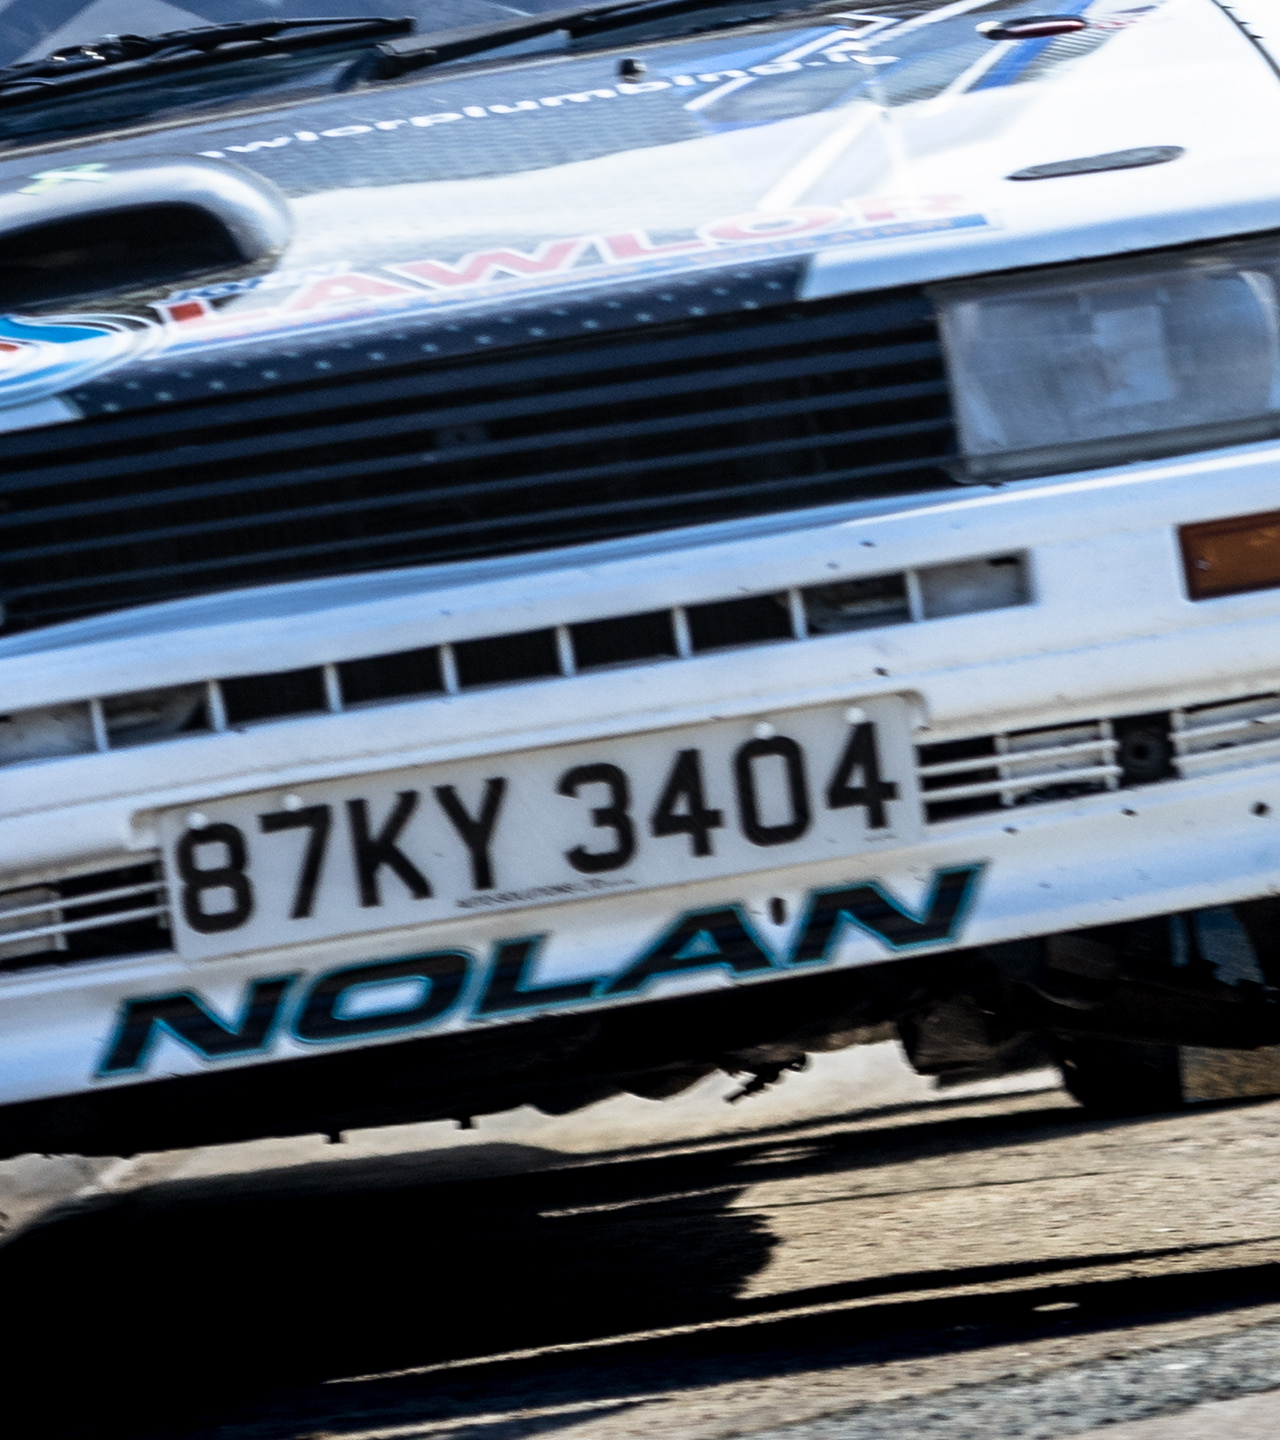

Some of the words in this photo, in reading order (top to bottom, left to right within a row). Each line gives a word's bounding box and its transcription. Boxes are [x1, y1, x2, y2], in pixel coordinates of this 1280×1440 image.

[160, 191, 970, 330] LAWLOR
[174, 778, 507, 934] 87KY
[556, 722, 898, 874] 3404
[92, 861, 987, 1079] NOLAN
